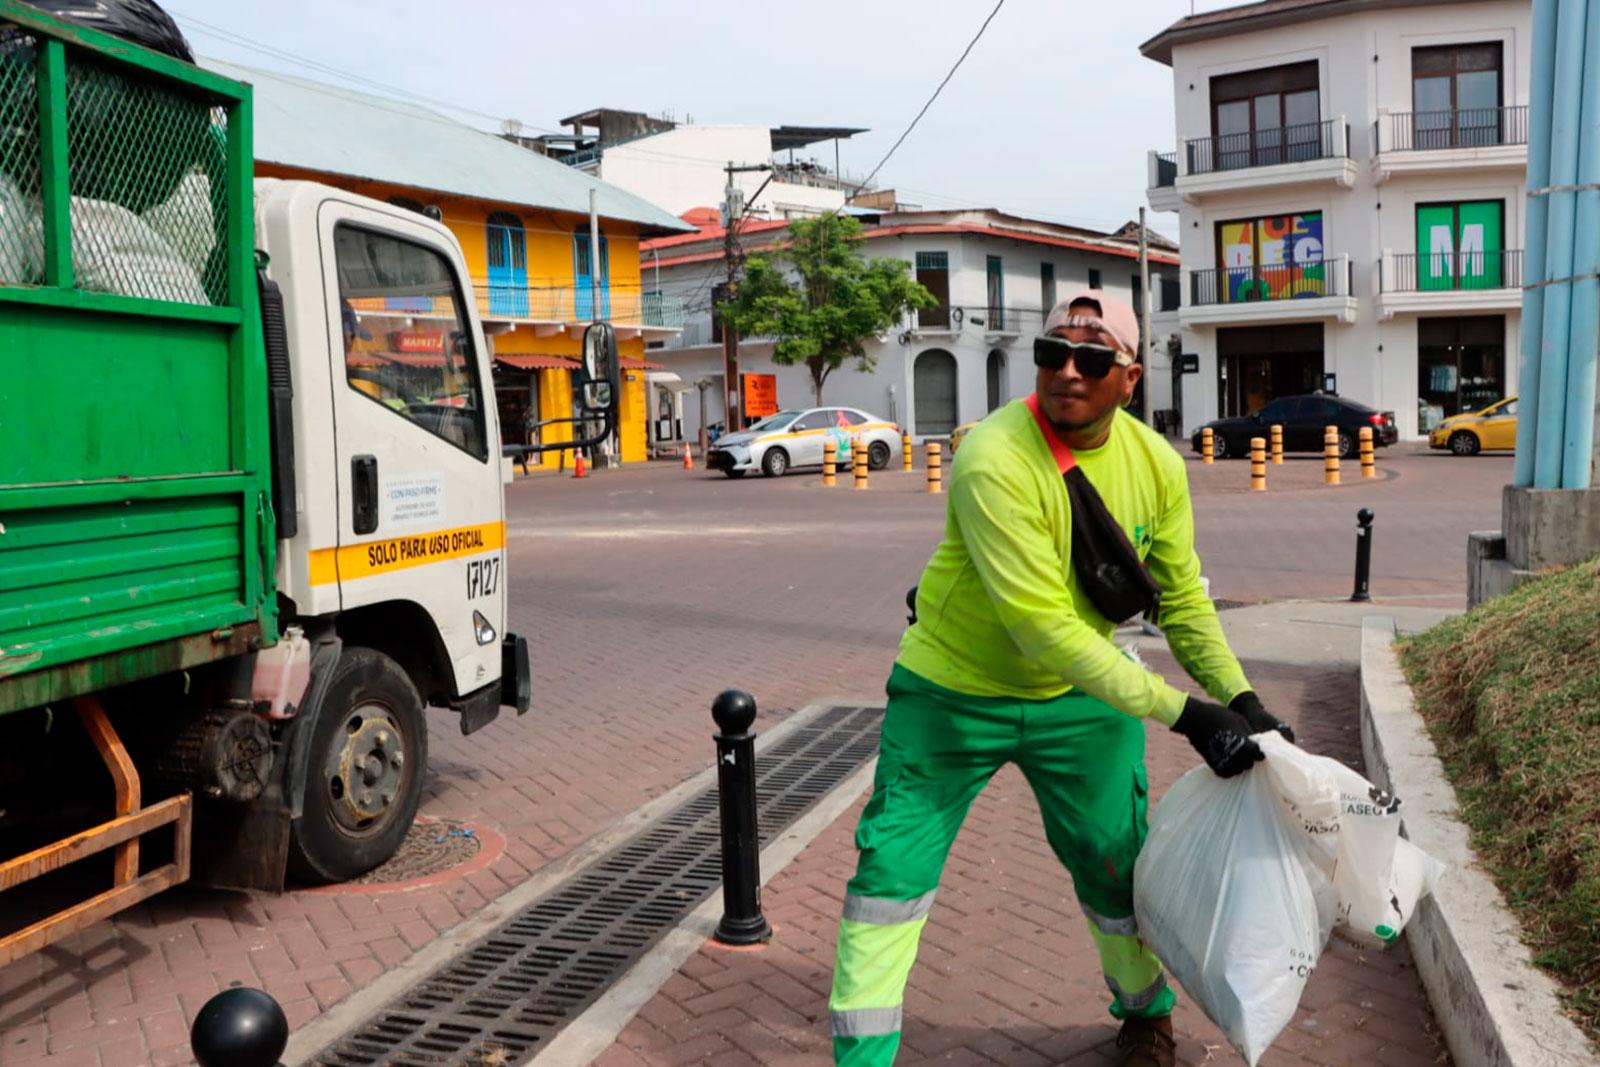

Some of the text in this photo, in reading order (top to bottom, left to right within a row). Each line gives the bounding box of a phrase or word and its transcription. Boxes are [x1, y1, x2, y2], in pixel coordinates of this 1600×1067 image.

[368, 529, 484, 567] SOLO PARA USO OFICIAL
